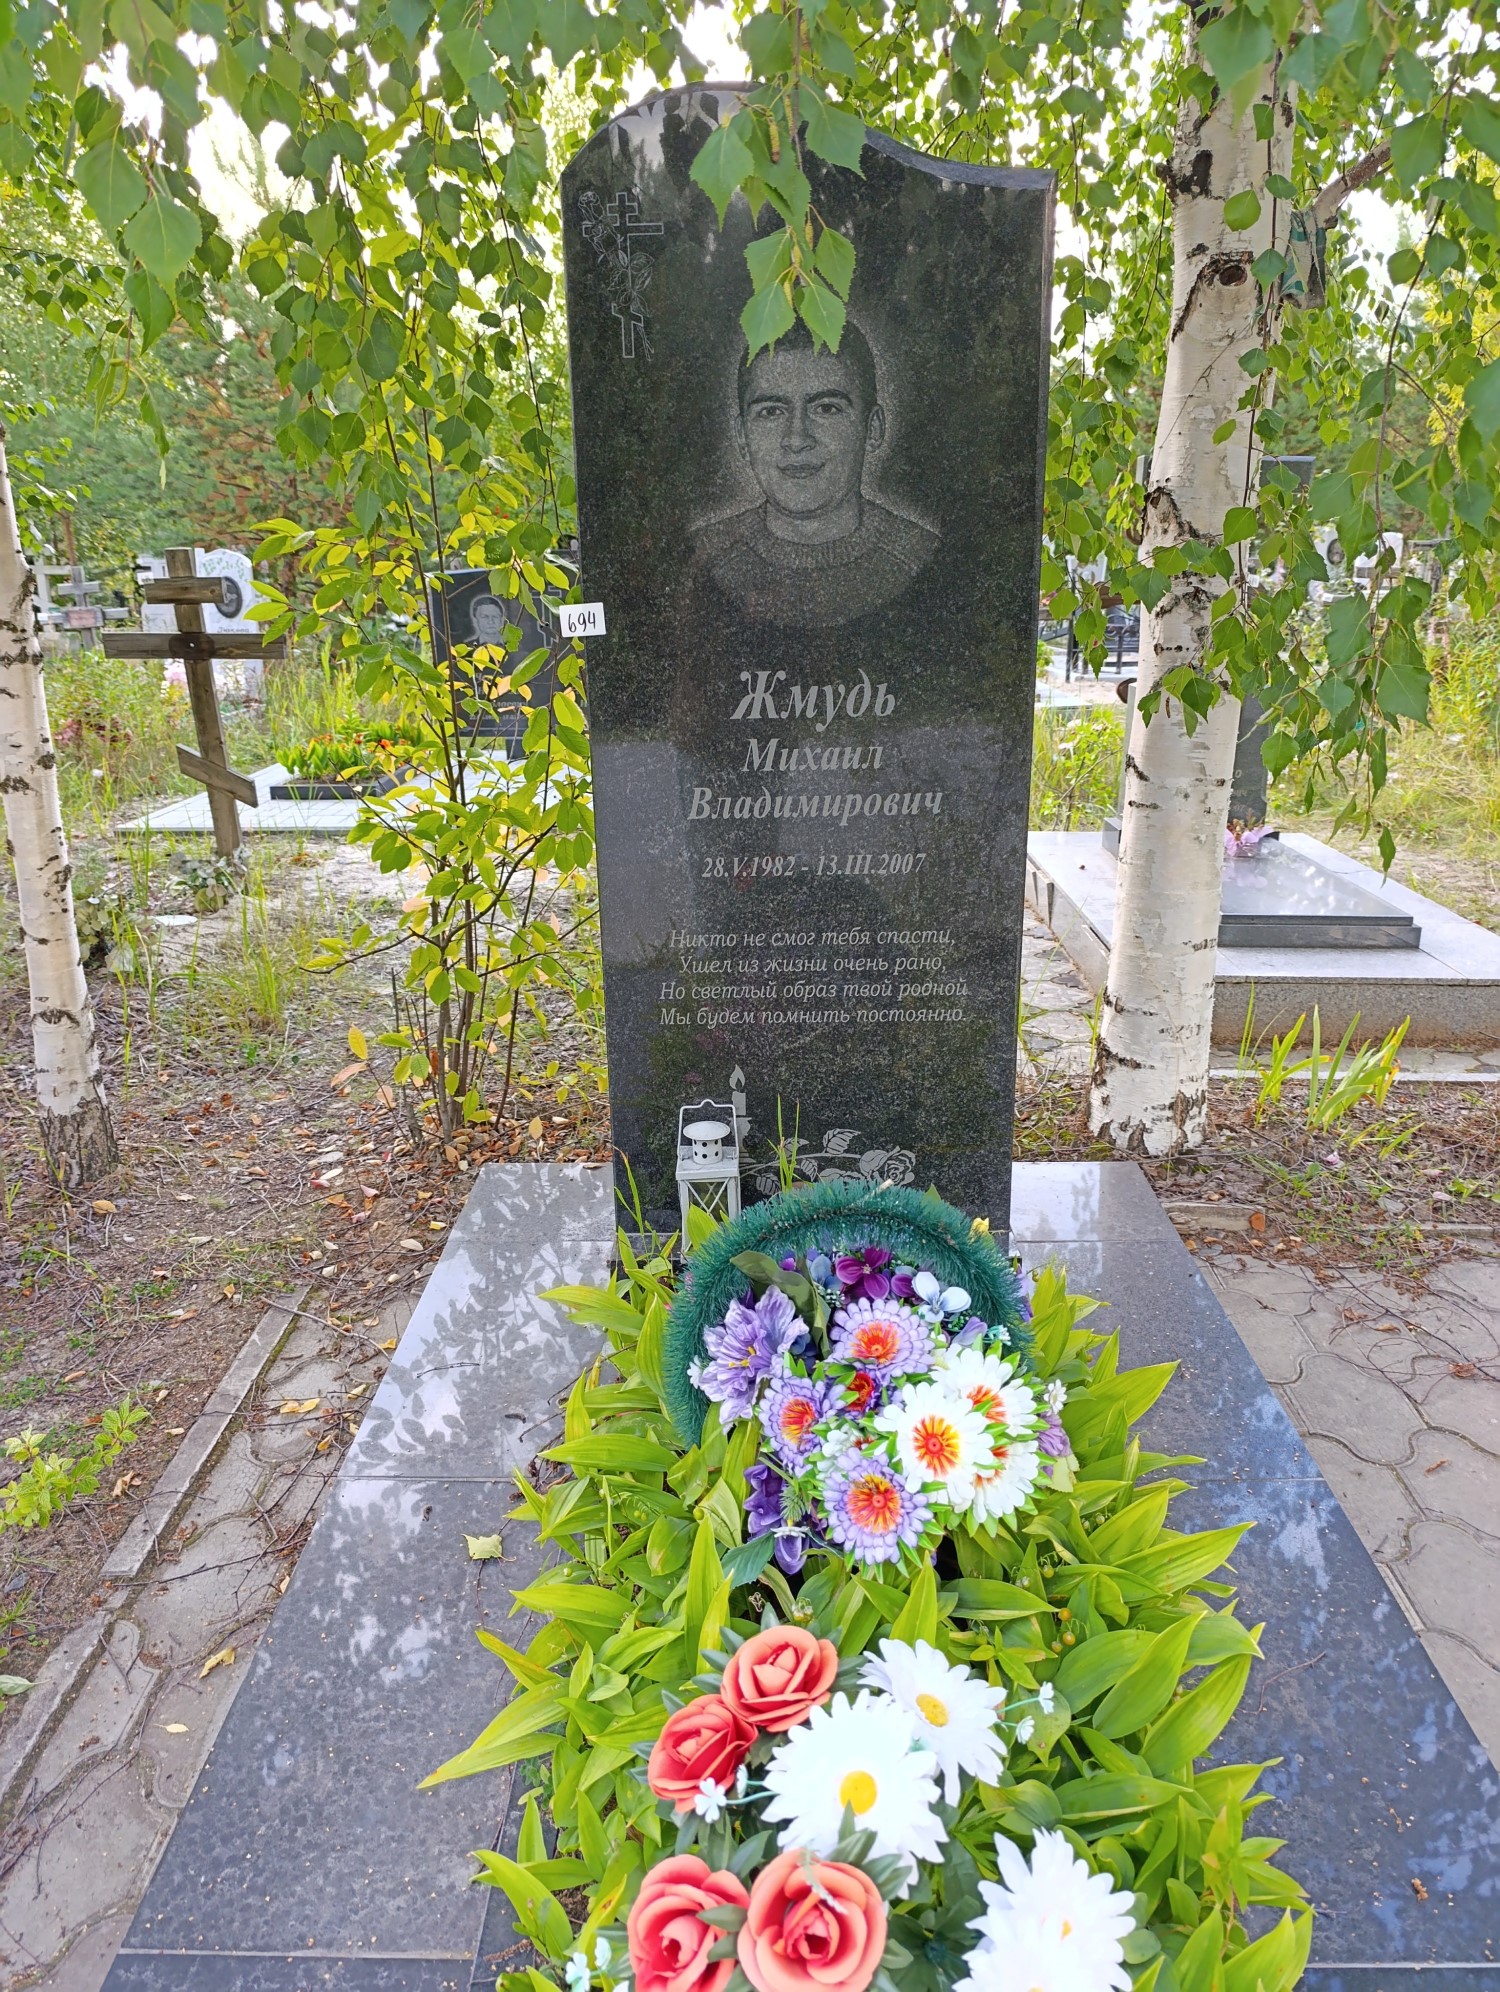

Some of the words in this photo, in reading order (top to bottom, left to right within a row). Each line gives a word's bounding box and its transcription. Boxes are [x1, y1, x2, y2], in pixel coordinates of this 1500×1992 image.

[568, 610, 596, 633] 694
[729, 668, 896, 732] Жмудь
[741, 738, 884, 772] Михаил
[687, 786, 943, 826] Владимирович
[701, 856, 796, 878] 28.V.1982
[816, 852, 927, 876] 13.III.2007
[670, 929, 737, 948] Никто
[743, 933, 766, 946] не
[771, 932, 816, 946] смог
[821, 927, 871, 946] тебя
[877, 929, 956, 946] спасти,
[679, 955, 732, 974] Ушел
[738, 959, 759, 973] из
[764, 957, 828, 973] жизни
[833, 957, 889, 972] очень
[893, 956, 946, 976] рано,
[659, 982, 686, 1000] Но
[691, 981, 778, 999] светлый
[783, 980, 837, 1003] образ
[843, 979, 893, 998] твой
[896, 978, 970, 1001] родной
[659, 1007, 691, 1025] Мы
[697, 1007, 756, 1029] будем
[761, 1009, 850, 1025] помнить
[856, 1008, 966, 1023] постоянно.
